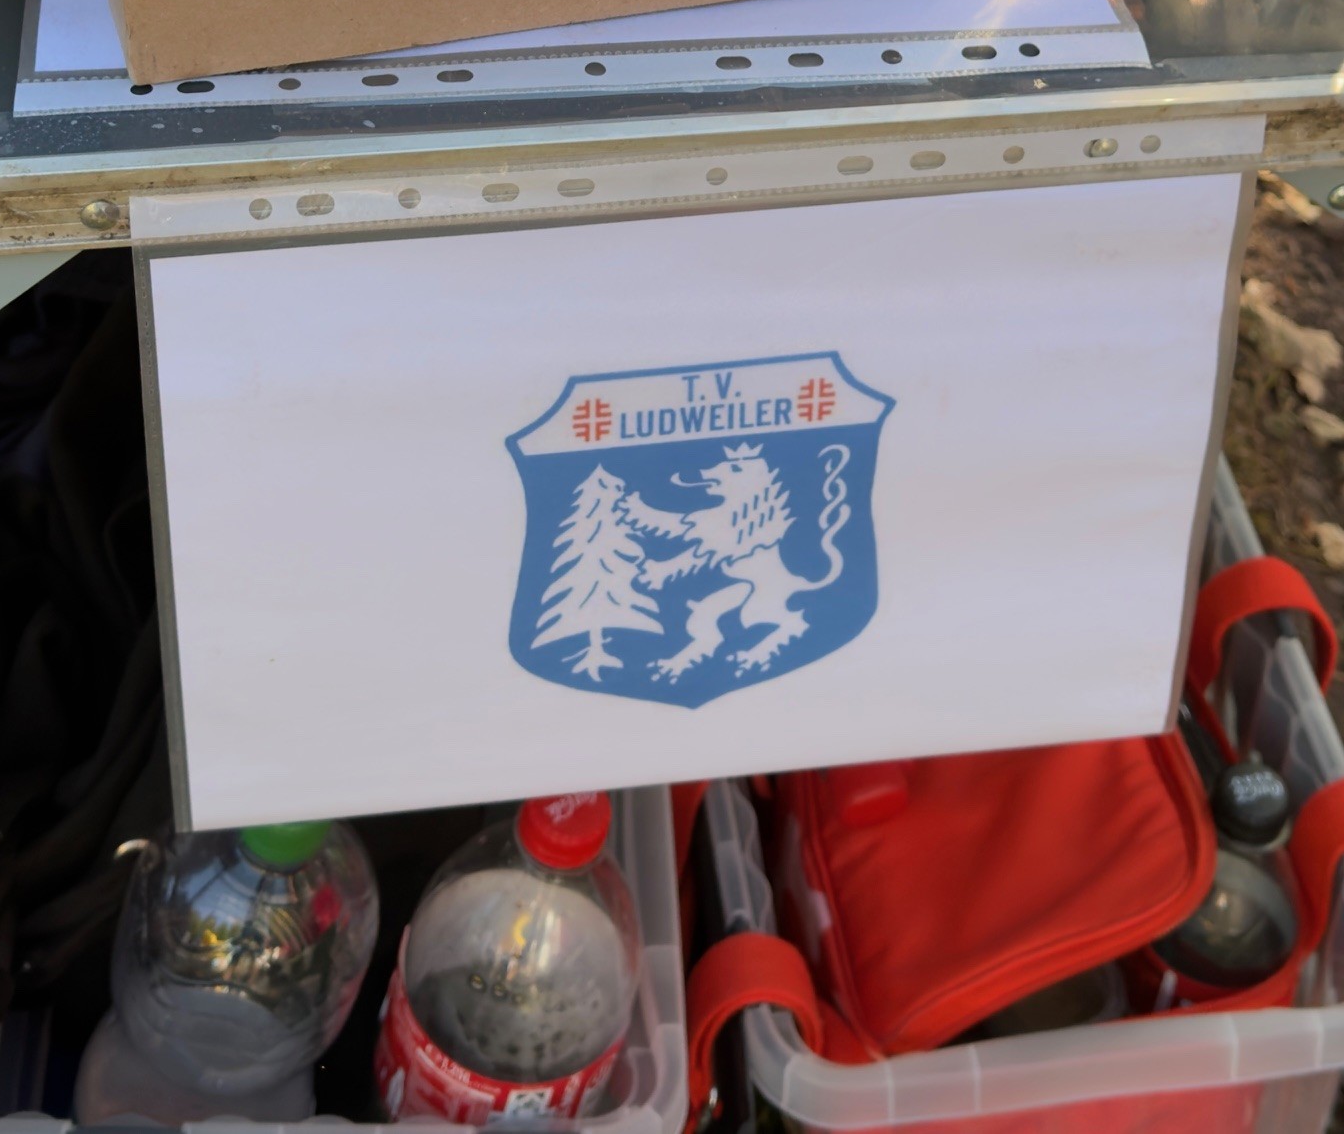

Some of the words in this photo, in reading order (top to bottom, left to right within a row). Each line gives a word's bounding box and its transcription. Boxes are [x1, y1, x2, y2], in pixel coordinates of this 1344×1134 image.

[681, 374, 706, 402] T.
[715, 371, 742, 399] V.
[619, 397, 793, 439] LUDWEILER
